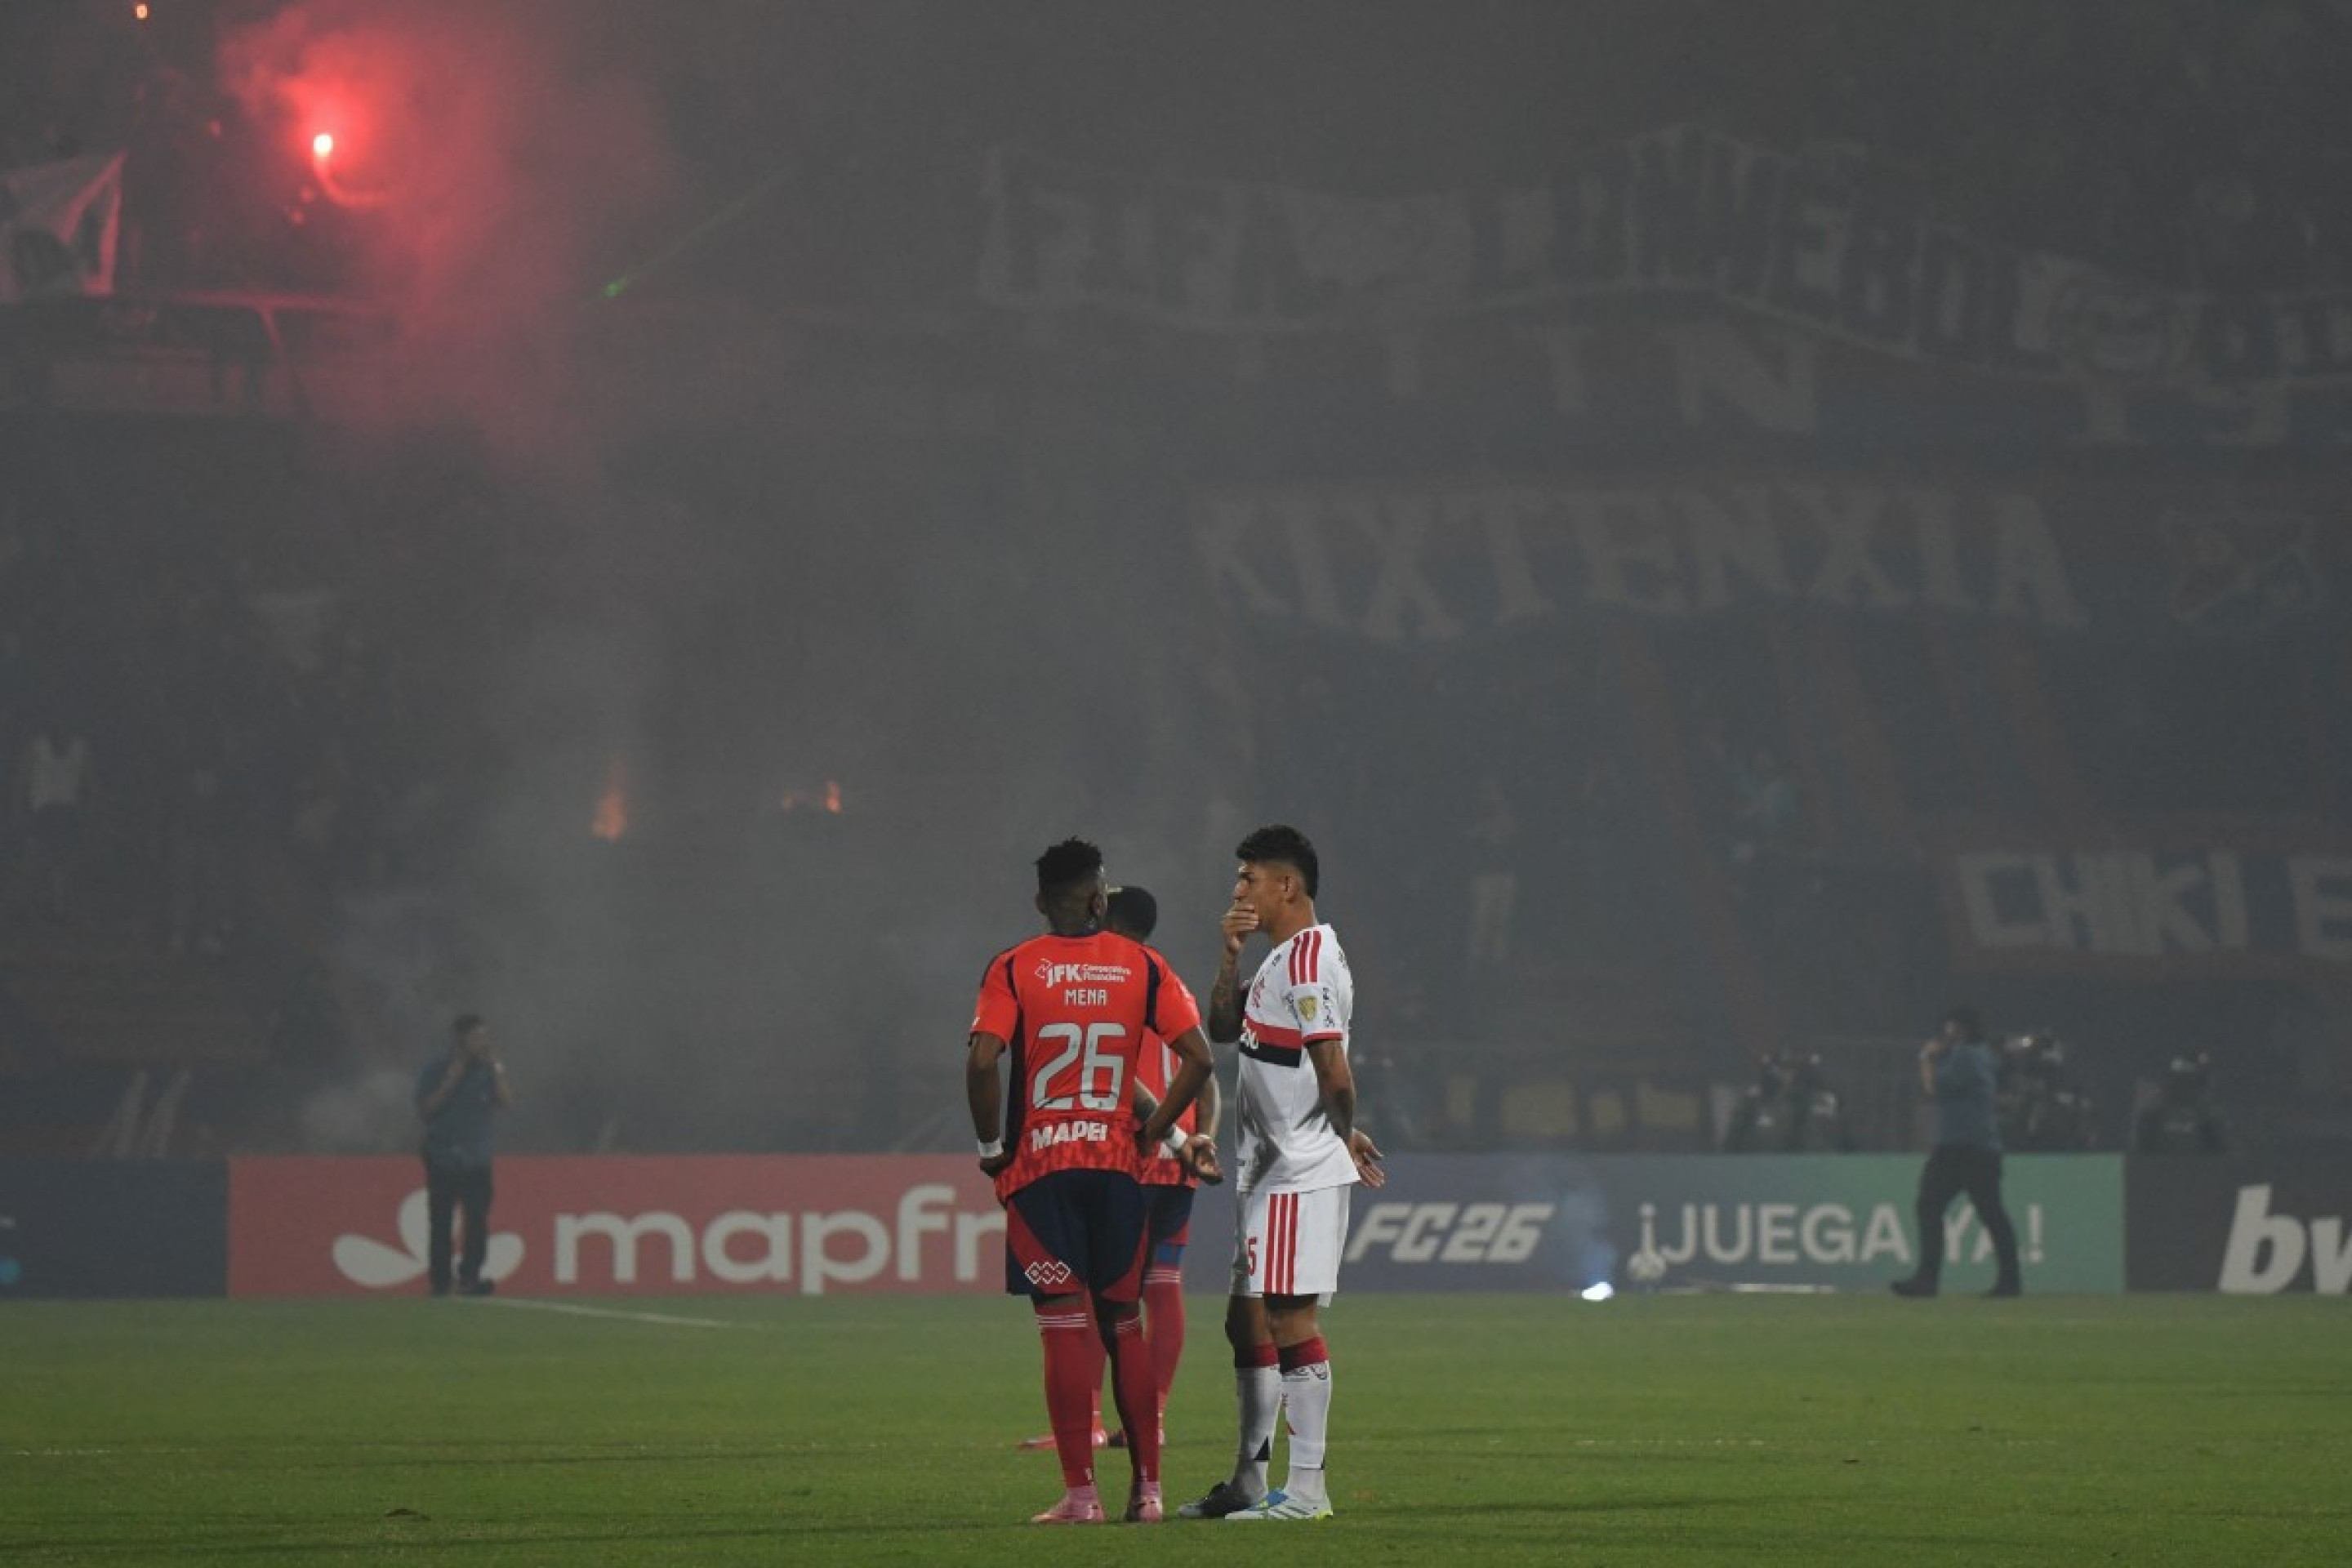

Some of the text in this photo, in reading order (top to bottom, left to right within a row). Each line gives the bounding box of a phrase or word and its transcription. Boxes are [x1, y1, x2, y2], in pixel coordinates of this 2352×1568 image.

[1194, 488, 2091, 641] KIXTENXIA
[1957, 849, 2247, 956] CHIKI
[1065, 989, 1107, 1007] MENA
[1032, 1022, 1126, 1111] 26
[1031, 1120, 1108, 1152] MAPEI
[552, 1183, 1006, 1295] mapfr
